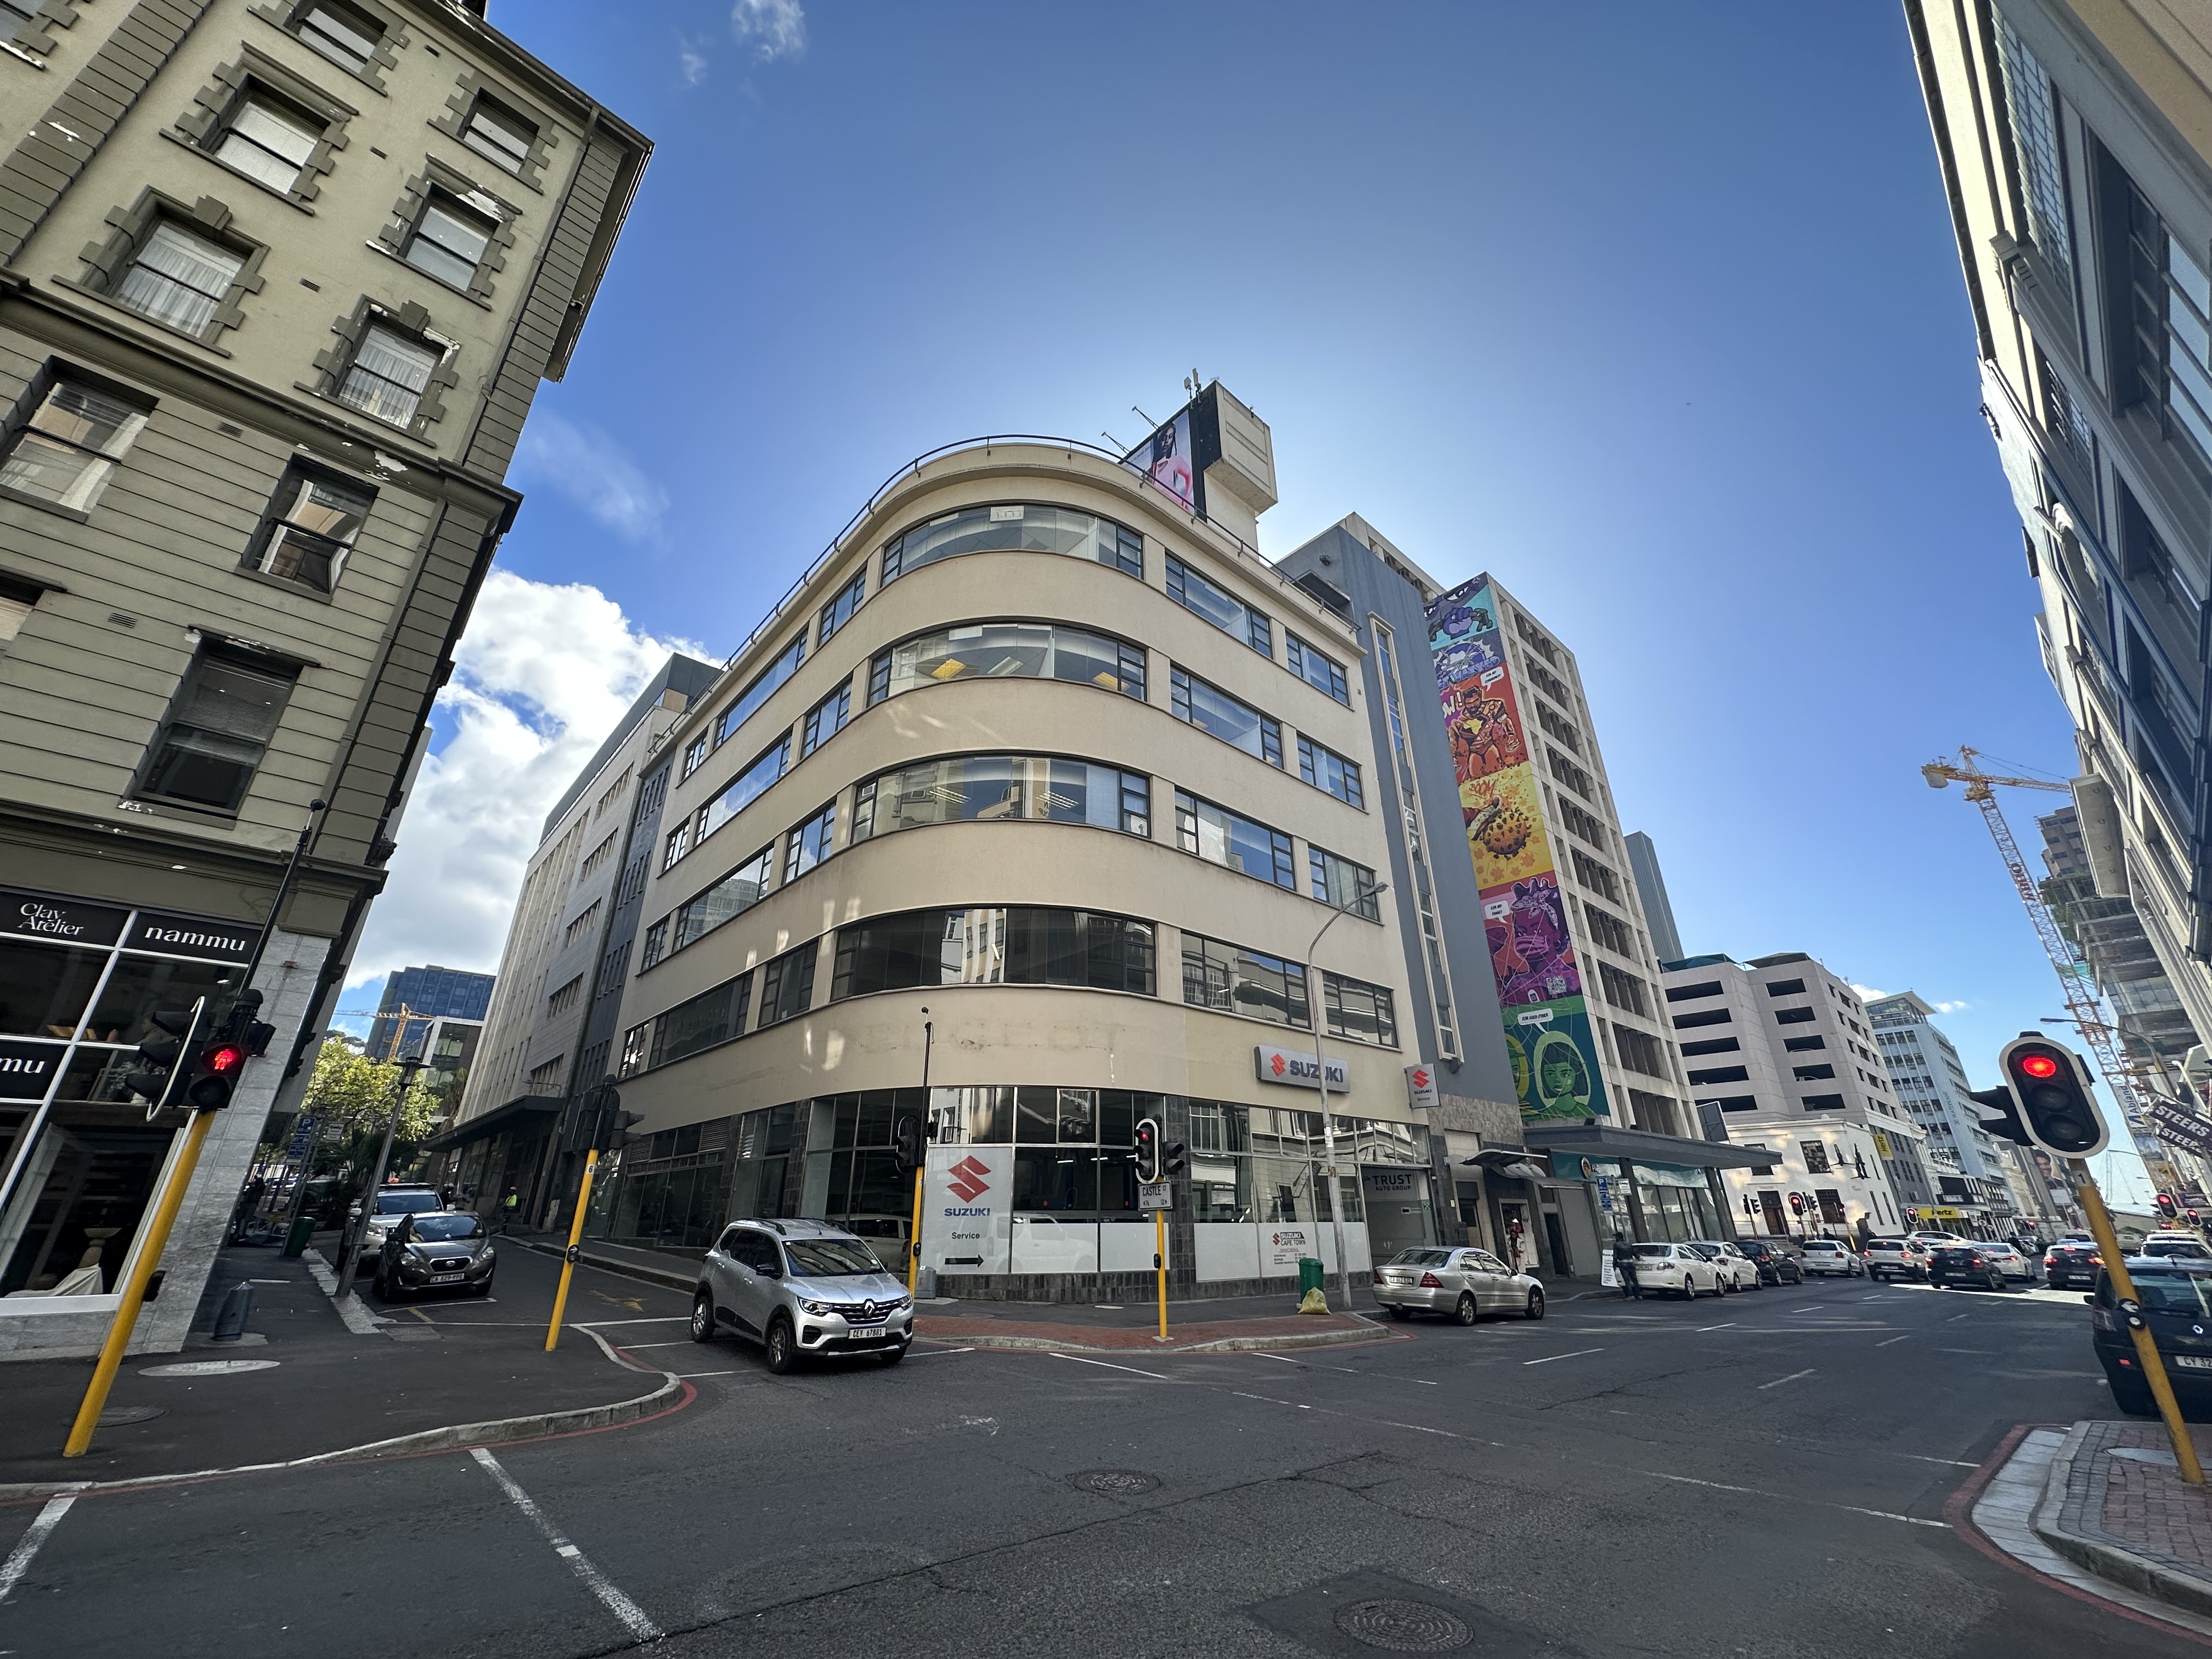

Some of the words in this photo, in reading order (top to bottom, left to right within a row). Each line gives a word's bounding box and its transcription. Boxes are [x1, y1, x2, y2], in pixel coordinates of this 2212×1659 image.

[1437, 676, 1450, 691] ET
[20, 903, 66, 922] Clay
[144, 926, 246, 951] nammu
[2118, 1086, 2139, 1114] Abland
[2155, 1105, 2210, 1137] STEERS
[2162, 1127, 2203, 1154] STEER
[1372, 1174, 1412, 1185] TRUST
[2078, 1173, 2086, 1184] 1
[1142, 1186, 1161, 1196] CASTLE
[944, 1207, 990, 1216] SUZUKI
[2183, 1357, 2197, 1366] CY
